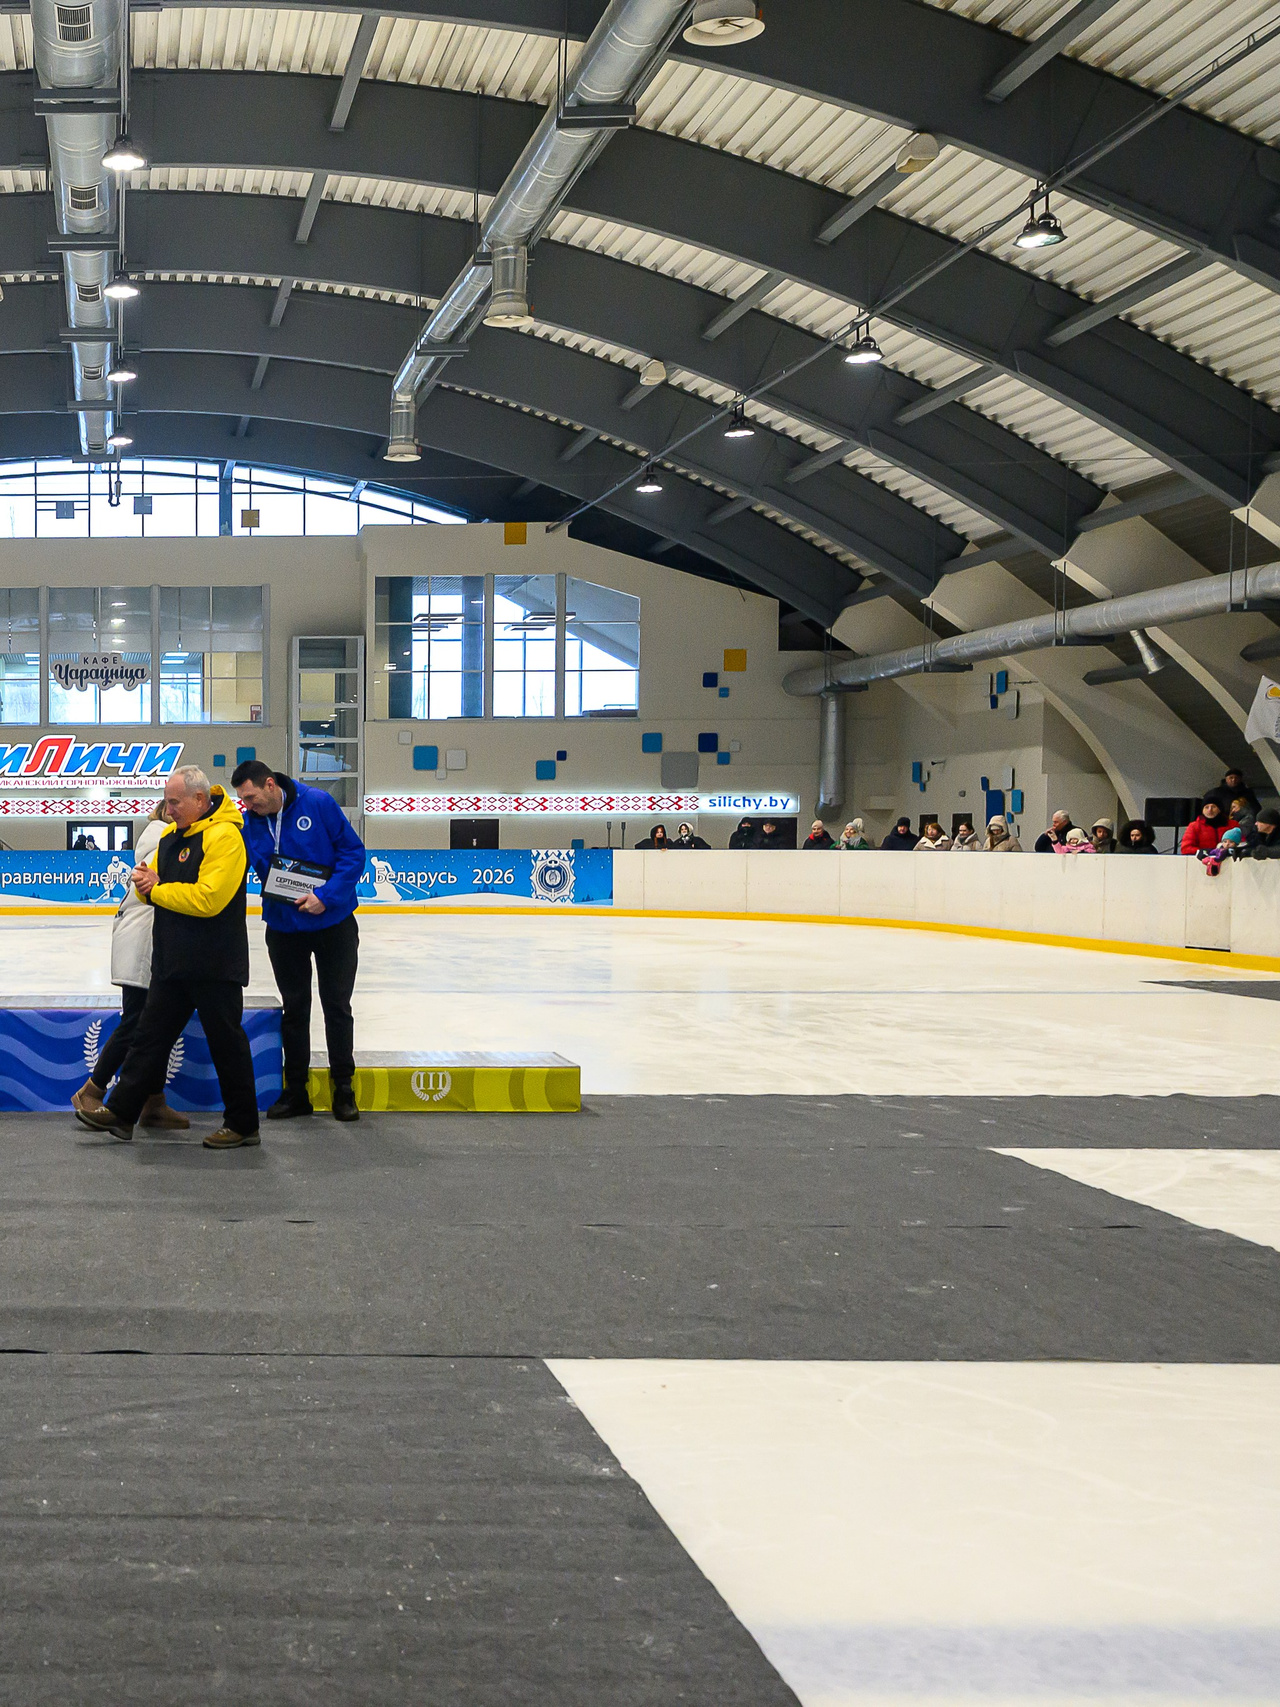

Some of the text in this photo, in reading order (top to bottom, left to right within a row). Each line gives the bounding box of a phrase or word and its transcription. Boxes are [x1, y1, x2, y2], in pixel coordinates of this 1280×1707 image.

[83, 656, 118, 665] КАФЕ
[708, 796, 790, 810] silichy.by
[375, 867, 458, 887] Беларусь
[472, 868, 515, 884] 2026
[418, 1071, 446, 1090] III
